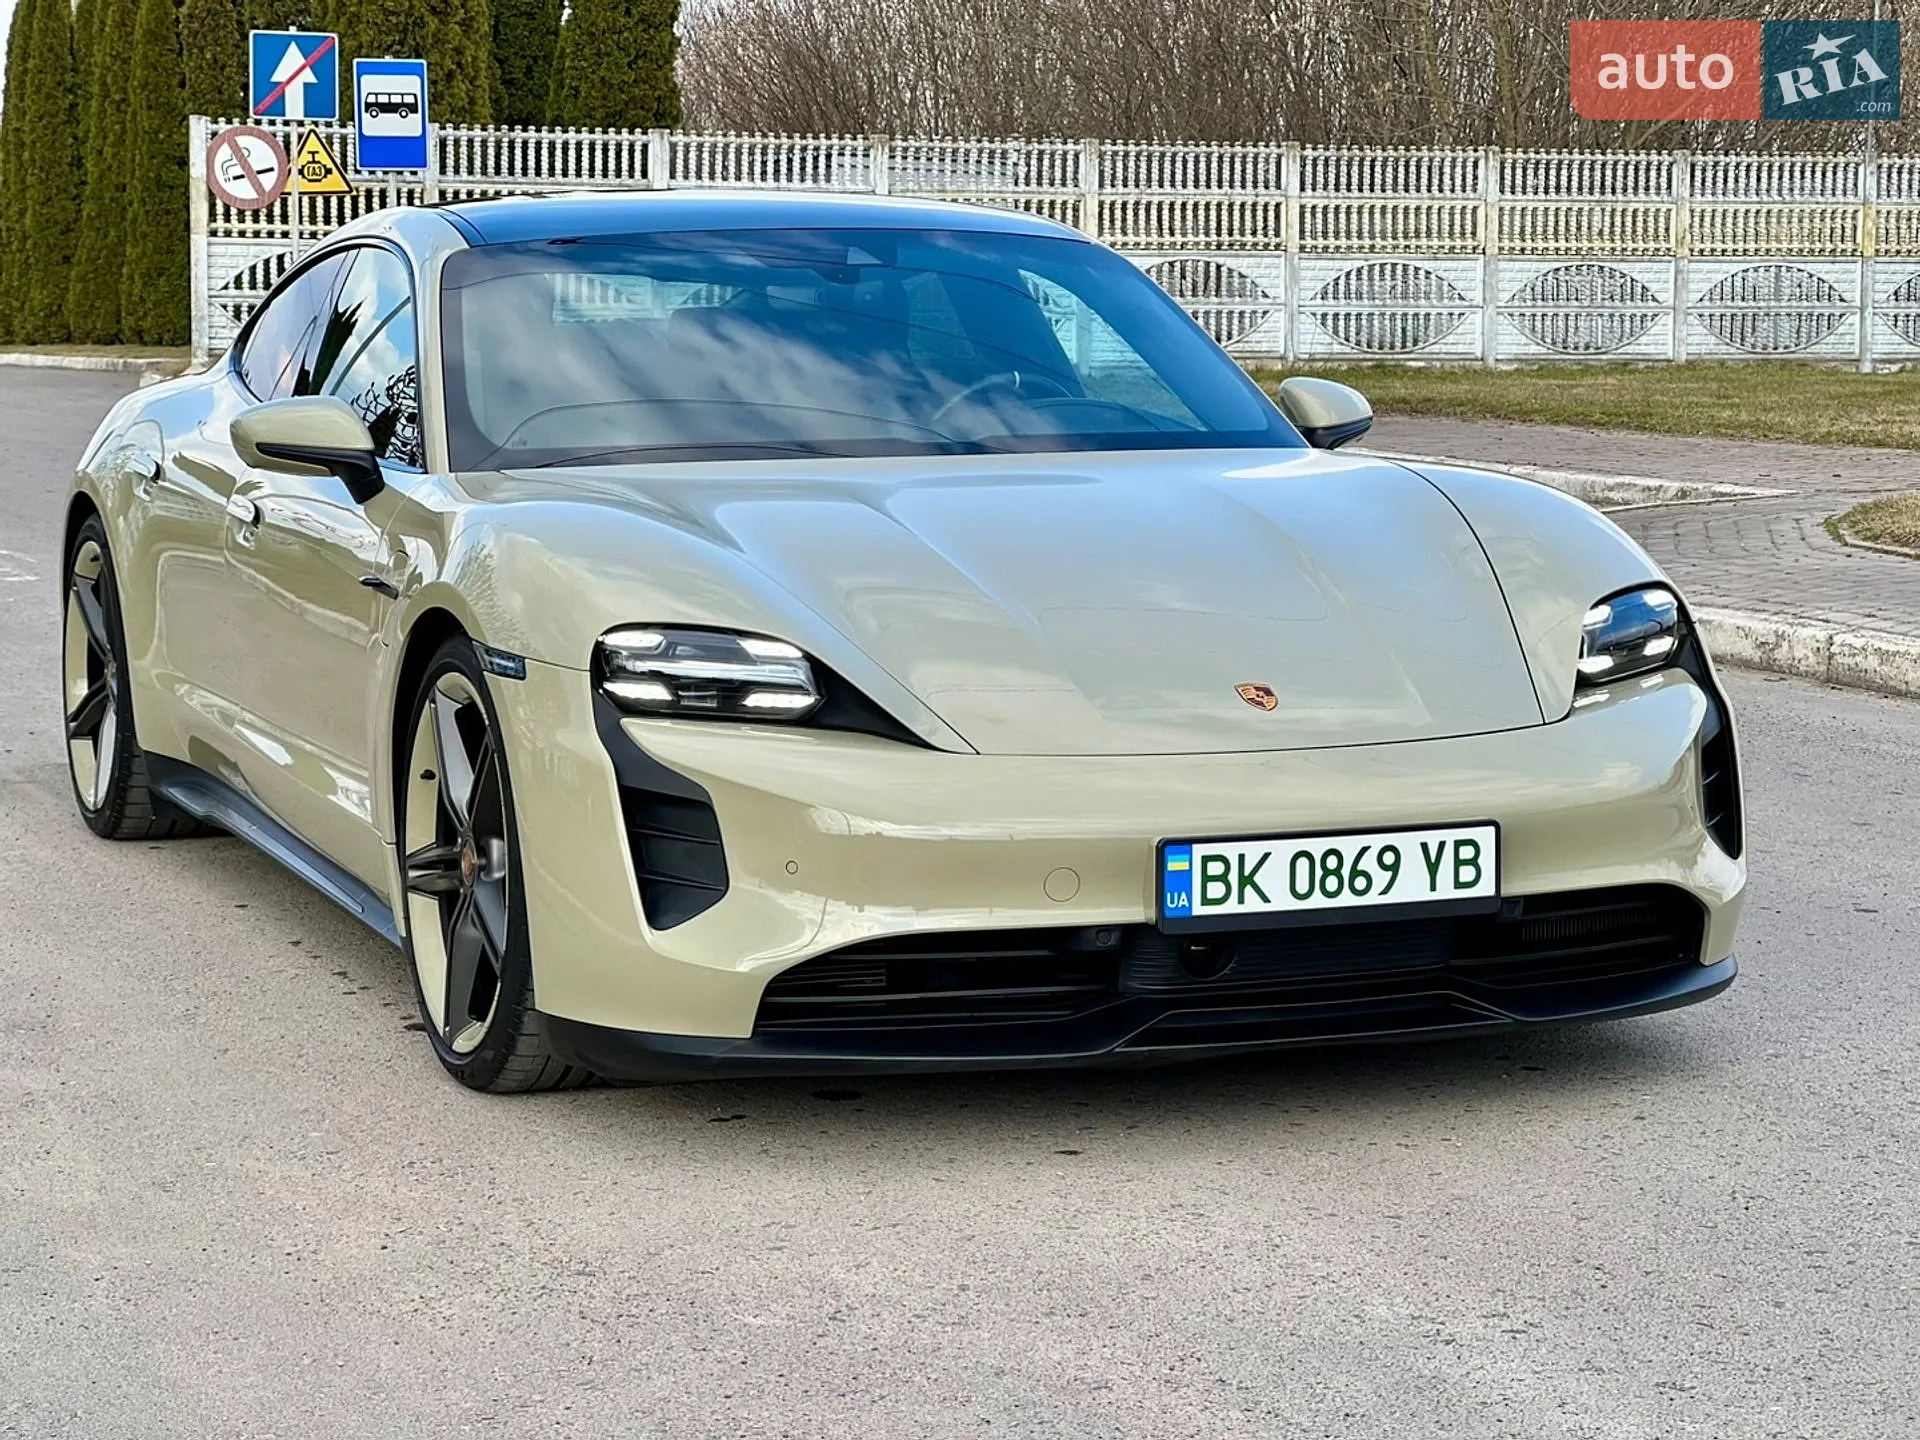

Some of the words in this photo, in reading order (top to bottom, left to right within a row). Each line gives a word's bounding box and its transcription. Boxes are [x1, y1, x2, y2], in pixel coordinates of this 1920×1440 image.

[306, 165, 323, 177] ГАЗ
[1200, 852, 1271, 906] BK
[1289, 844, 1402, 901] 0869
[1420, 838, 1483, 892] YB
[1166, 892, 1189, 908] UA
